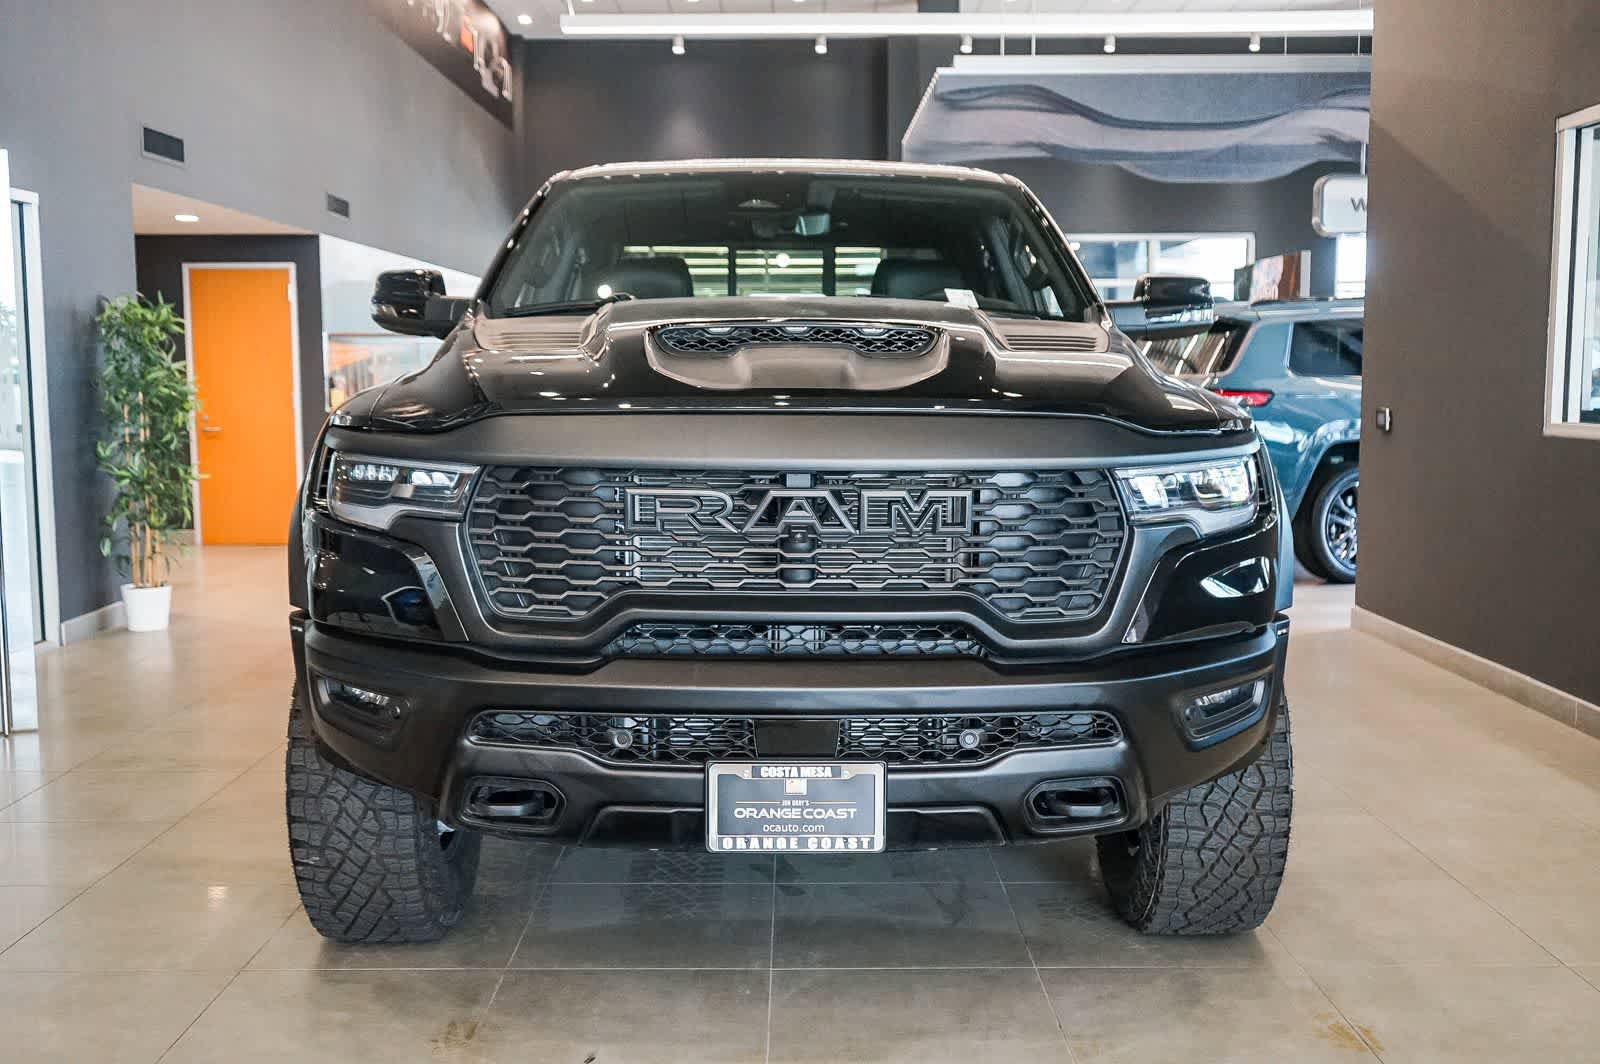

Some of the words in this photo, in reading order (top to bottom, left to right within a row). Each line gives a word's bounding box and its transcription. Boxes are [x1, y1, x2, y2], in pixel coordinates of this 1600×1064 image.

[624, 488, 974, 535] RAM
[760, 766, 799, 778] COSTA
[800, 766, 832, 778] MESA
[734, 808, 802, 819] ORANGE
[803, 808, 857, 819] COAST
[763, 823, 825, 833] ocauto.com
[722, 837, 799, 850] ORANGE
[807, 837, 871, 850] COAST
